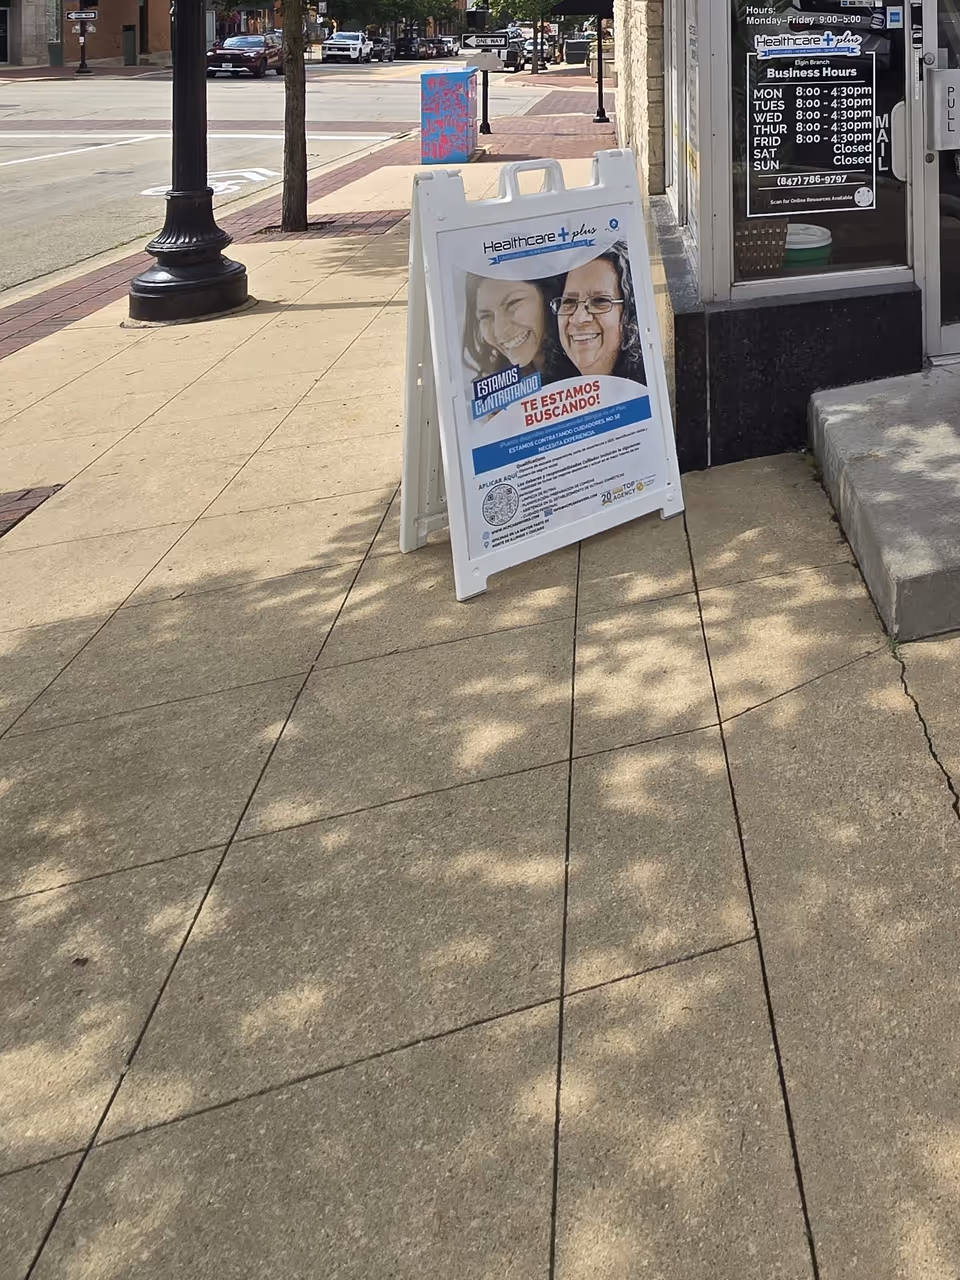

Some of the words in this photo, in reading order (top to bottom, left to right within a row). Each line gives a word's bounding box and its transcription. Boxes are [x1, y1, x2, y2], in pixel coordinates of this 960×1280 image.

[746, 6, 776, 15] Hours:
[756, 36, 821, 48] Healthcare
[836, 31, 861, 48] plus
[795, 59, 809, 67] Elgin
[810, 58, 830, 66] Branch
[766, 68, 821, 79] Business
[822, 67, 857, 77] Hours
[753, 88, 783, 99] MON
[795, 87, 821, 96] 8:00
[830, 86, 872, 97] 4:30pm
[753, 100, 786, 111] TUES
[795, 99, 821, 108] 8:00
[830, 98, 872, 109] 4:30pm
[947, 86, 955, 132] PULL
[753, 112, 783, 123] WED
[795, 111, 821, 120] 8:00
[830, 110, 872, 121] 4:30pm
[753, 124, 788, 135] THUR
[795, 122, 821, 132] 8:00
[830, 121, 872, 132] 4:30pm
[753, 136, 781, 147] FRID
[795, 134, 821, 144] 8:00
[830, 133, 872, 144] 4:30pm
[875, 113, 889, 171] MAIL
[753, 148, 777, 159] SAT
[833, 142, 872, 154] Closed
[753, 160, 780, 171] SUN
[833, 154, 872, 165] Closed
[777, 175, 802, 186] (847)
[803, 174, 848, 185] 786-9797
[483, 231, 556, 255] Healthcare
[571, 223, 598, 242] plus
[476, 368, 519, 398] ESTAMOS
[475, 380, 539, 415] CONTRATANDO
[521, 398, 539, 413] TE
[540, 380, 600, 409] ESTAMOS
[524, 394, 601, 427] BUSCANDO!
[508, 440, 533, 454] ESTAMOS
[534, 427, 573, 445] CONTRATANDO
[604, 414, 613, 422] NO
[538, 439, 563, 452] NECESITA
[478, 477, 502, 490] APLICAR
[601, 491, 612, 503] 20
[622, 480, 636, 490] TOP
[613, 487, 636, 501] AGENCY
